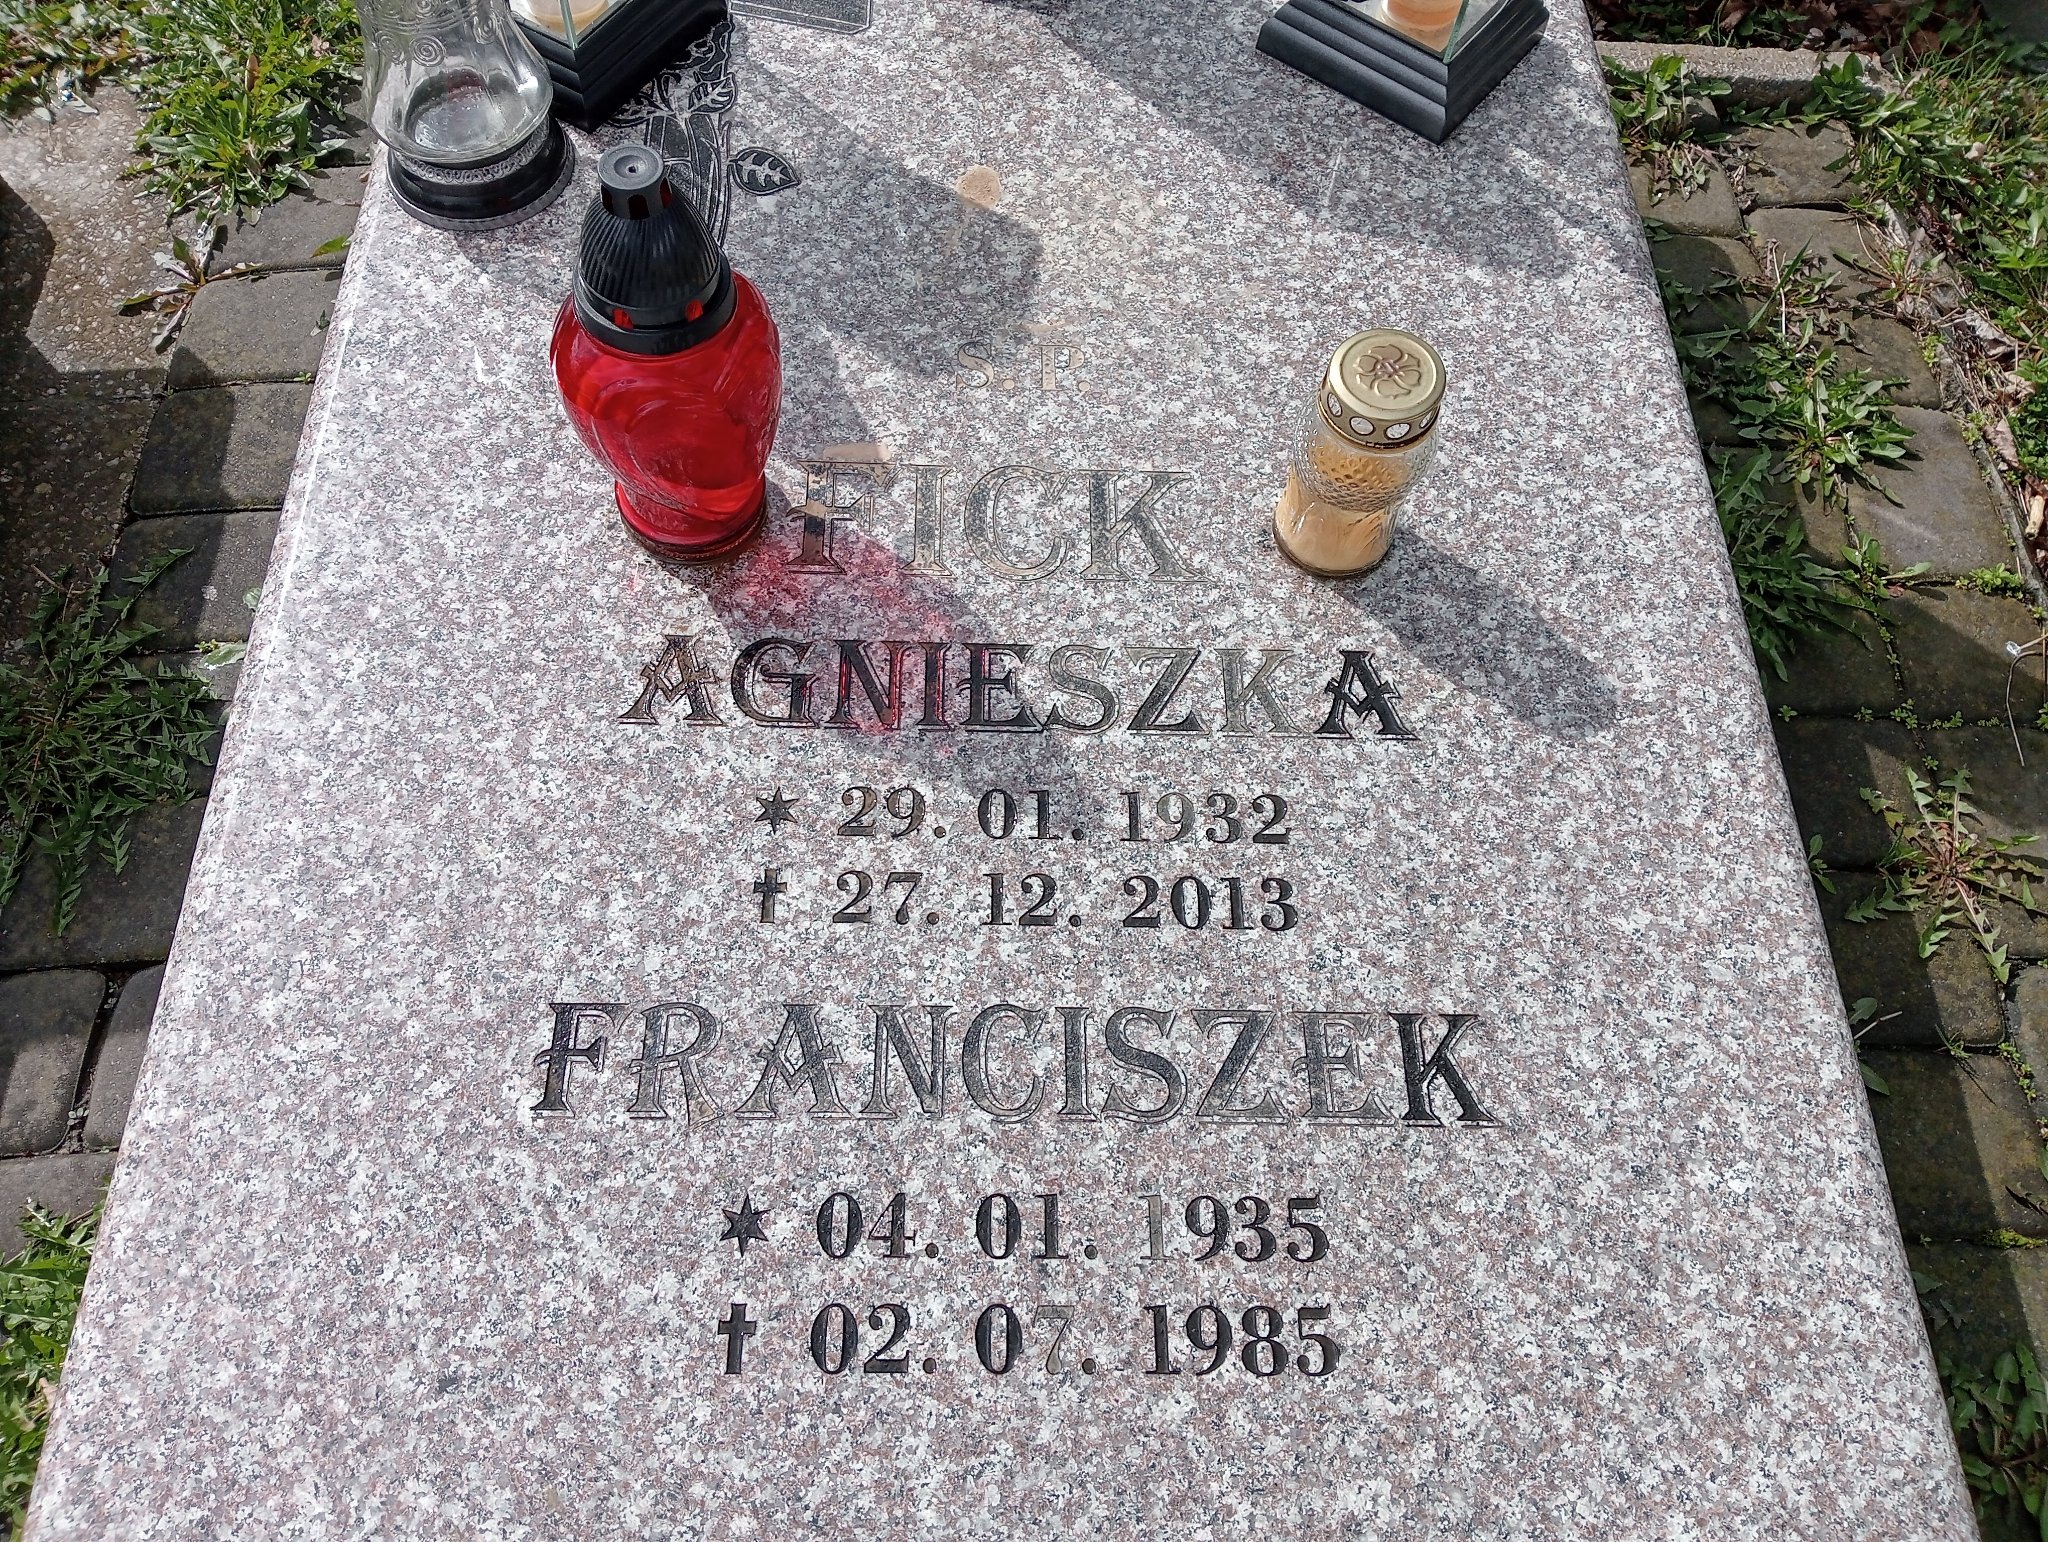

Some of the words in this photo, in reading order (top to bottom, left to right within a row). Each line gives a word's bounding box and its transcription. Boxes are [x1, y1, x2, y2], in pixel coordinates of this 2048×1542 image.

[785, 460, 1215, 584] FICK
[617, 634, 1420, 740] AGNIESZKA
[837, 786, 947, 838] 29.
[978, 788, 1084, 841] 01.
[1120, 790, 1290, 845] 1932
[832, 870, 940, 926] 27.
[982, 872, 1082, 928] 12.
[1122, 875, 1298, 932] 2013
[530, 1001, 1503, 1129] FRANCISZEK
[816, 1192, 940, 1260] 04.
[976, 1193, 1098, 1260] 01.
[1139, 1195, 1329, 1263] 1935
[810, 1303, 937, 1375] 02.
[974, 1302, 1096, 1376] 07.
[1142, 1303, 1341, 1378] 1985
